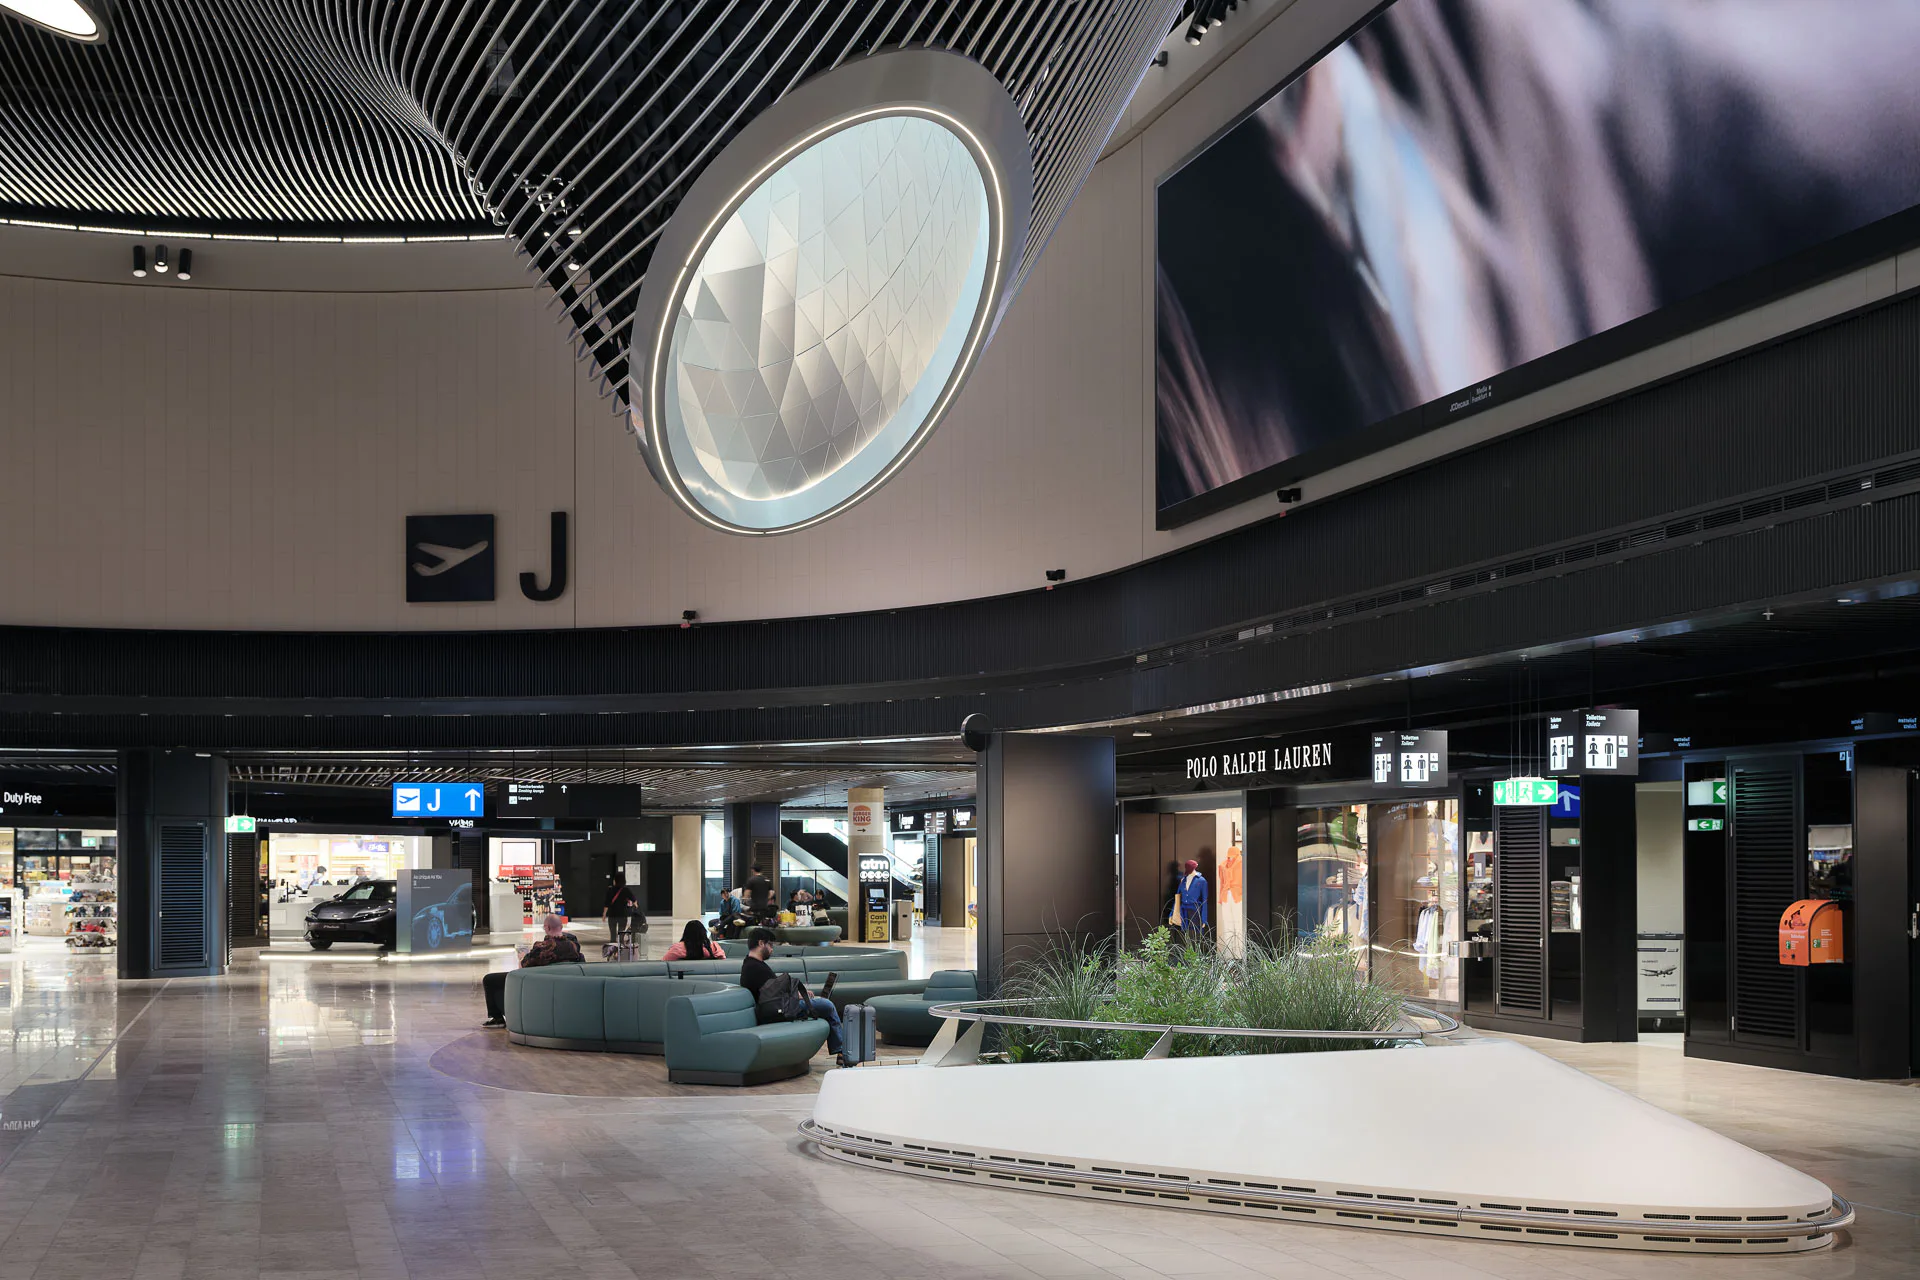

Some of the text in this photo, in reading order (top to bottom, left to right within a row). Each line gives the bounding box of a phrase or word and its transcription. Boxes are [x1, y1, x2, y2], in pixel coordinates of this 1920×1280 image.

[519, 511, 567, 602] J
[1186, 742, 1332, 779] POLO RALPH LAUREN
[3, 791, 42, 805] Duty Free
[426, 788, 441, 812] J
[853, 815, 872, 823] KING
[860, 858, 889, 870] atm
